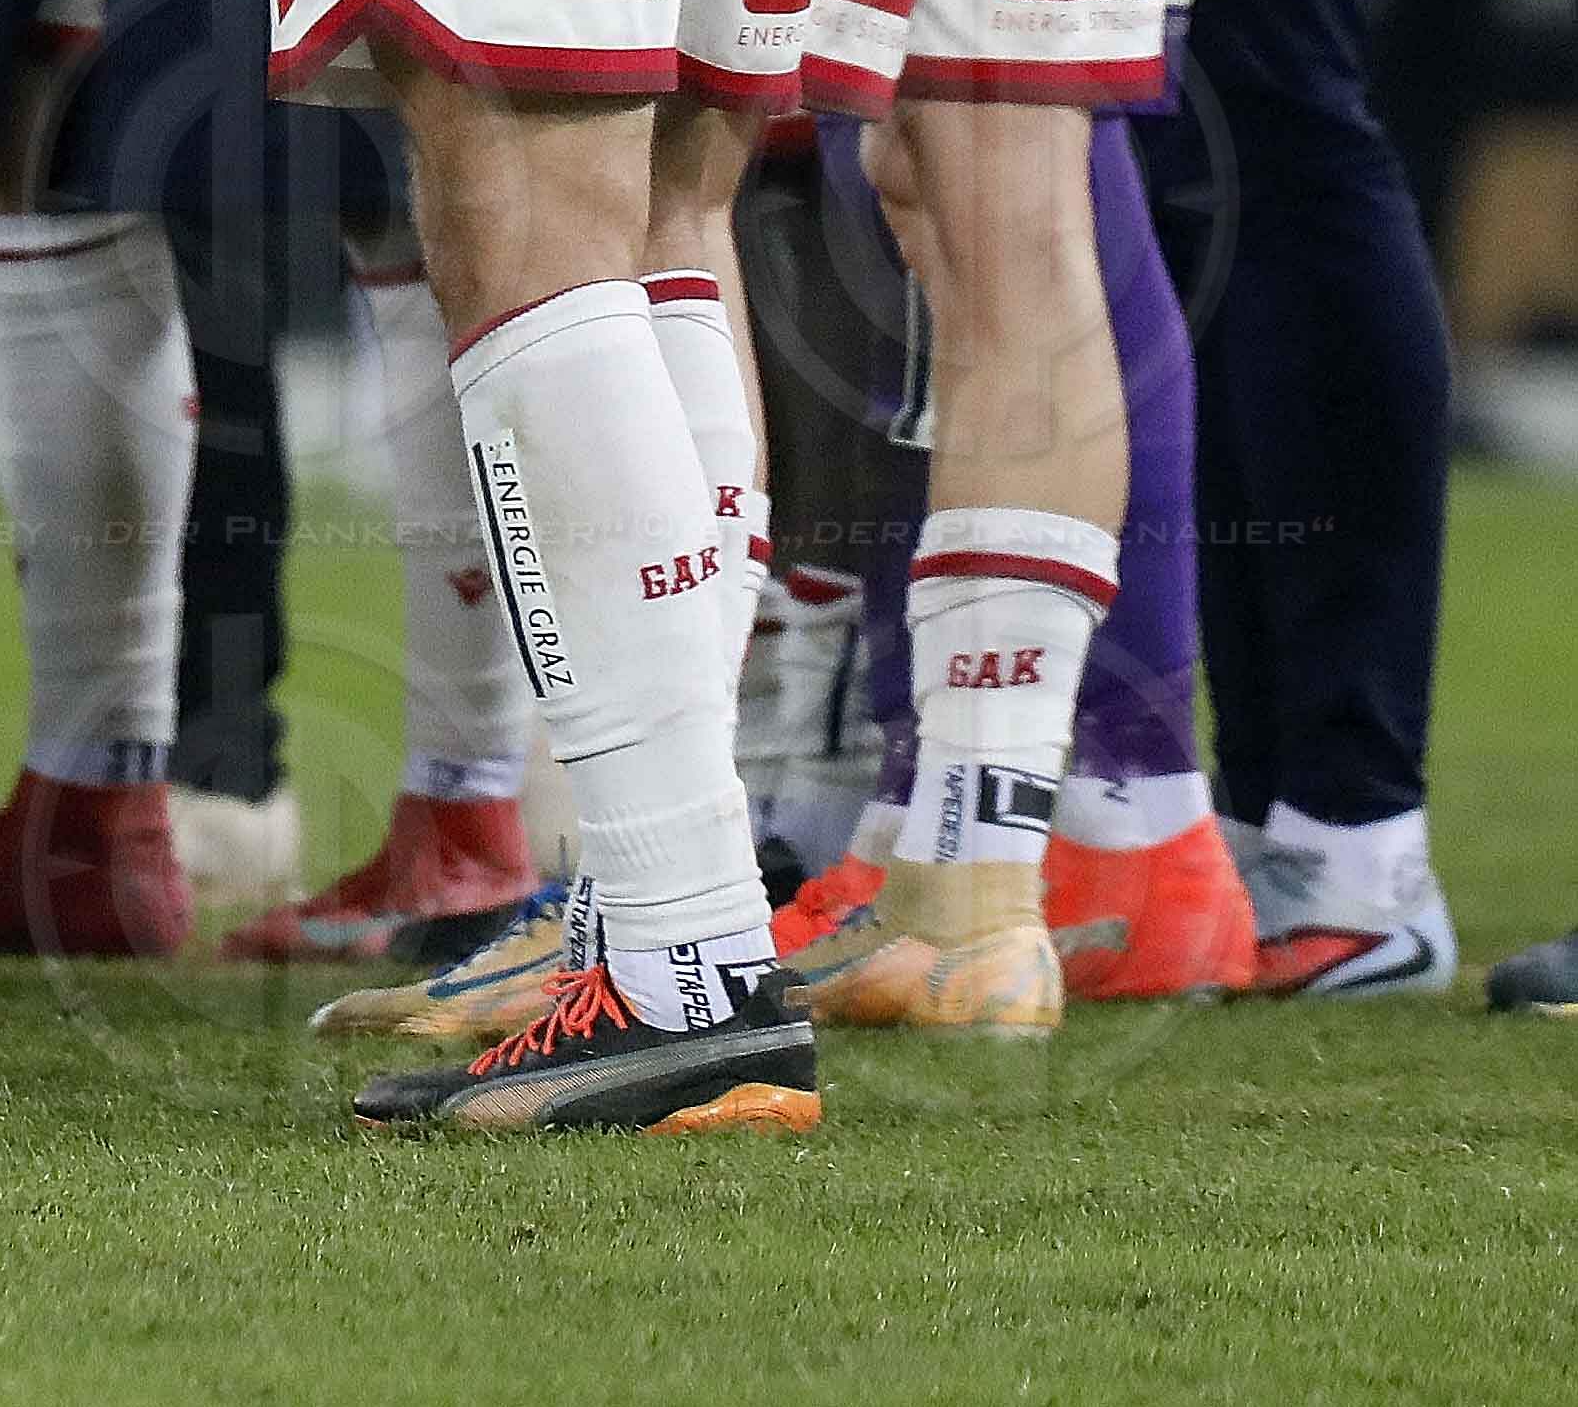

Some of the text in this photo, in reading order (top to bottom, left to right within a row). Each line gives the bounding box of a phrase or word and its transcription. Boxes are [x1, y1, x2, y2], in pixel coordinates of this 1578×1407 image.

[492, 461, 576, 688] ENERGIE GRAZ
[639, 545, 722, 602] GAK
[946, 646, 1046, 689] GAK
